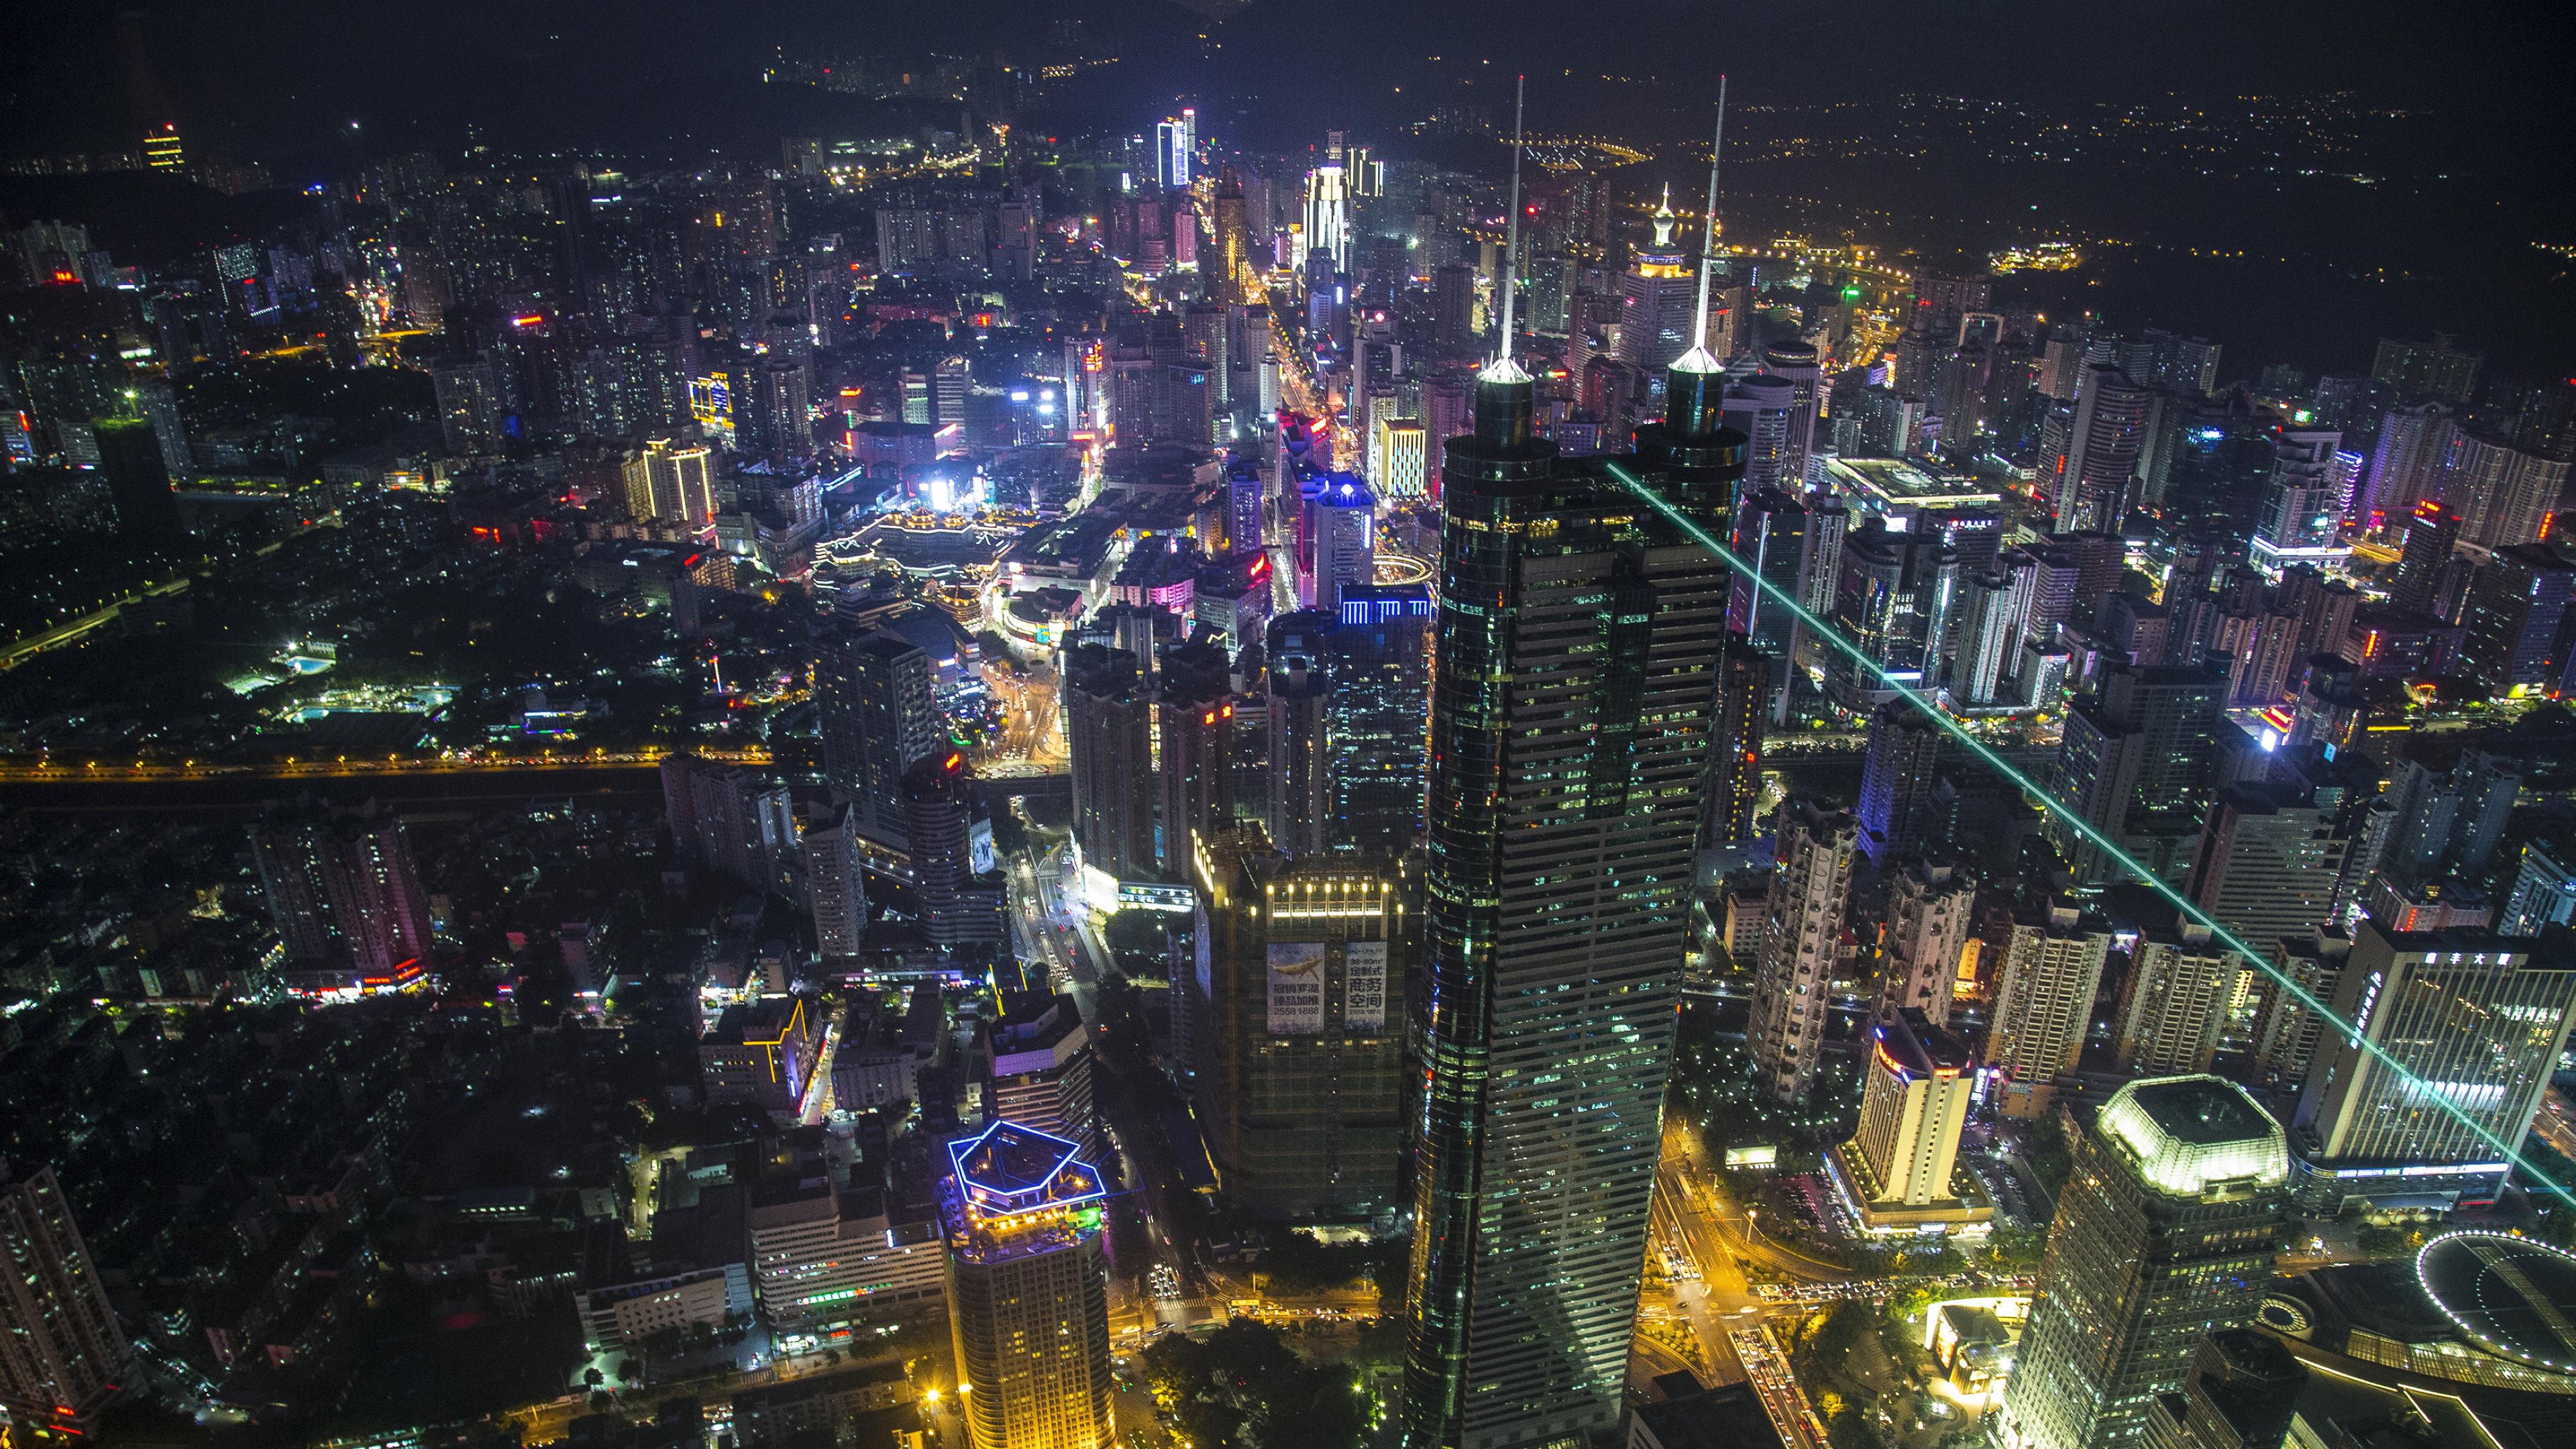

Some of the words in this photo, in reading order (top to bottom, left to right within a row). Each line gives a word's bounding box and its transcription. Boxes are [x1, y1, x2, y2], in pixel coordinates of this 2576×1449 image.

[1350, 966, 1383, 977] 定制式
[1350, 977, 1383, 993] 商务
[1349, 994, 1382, 1008] 空间
